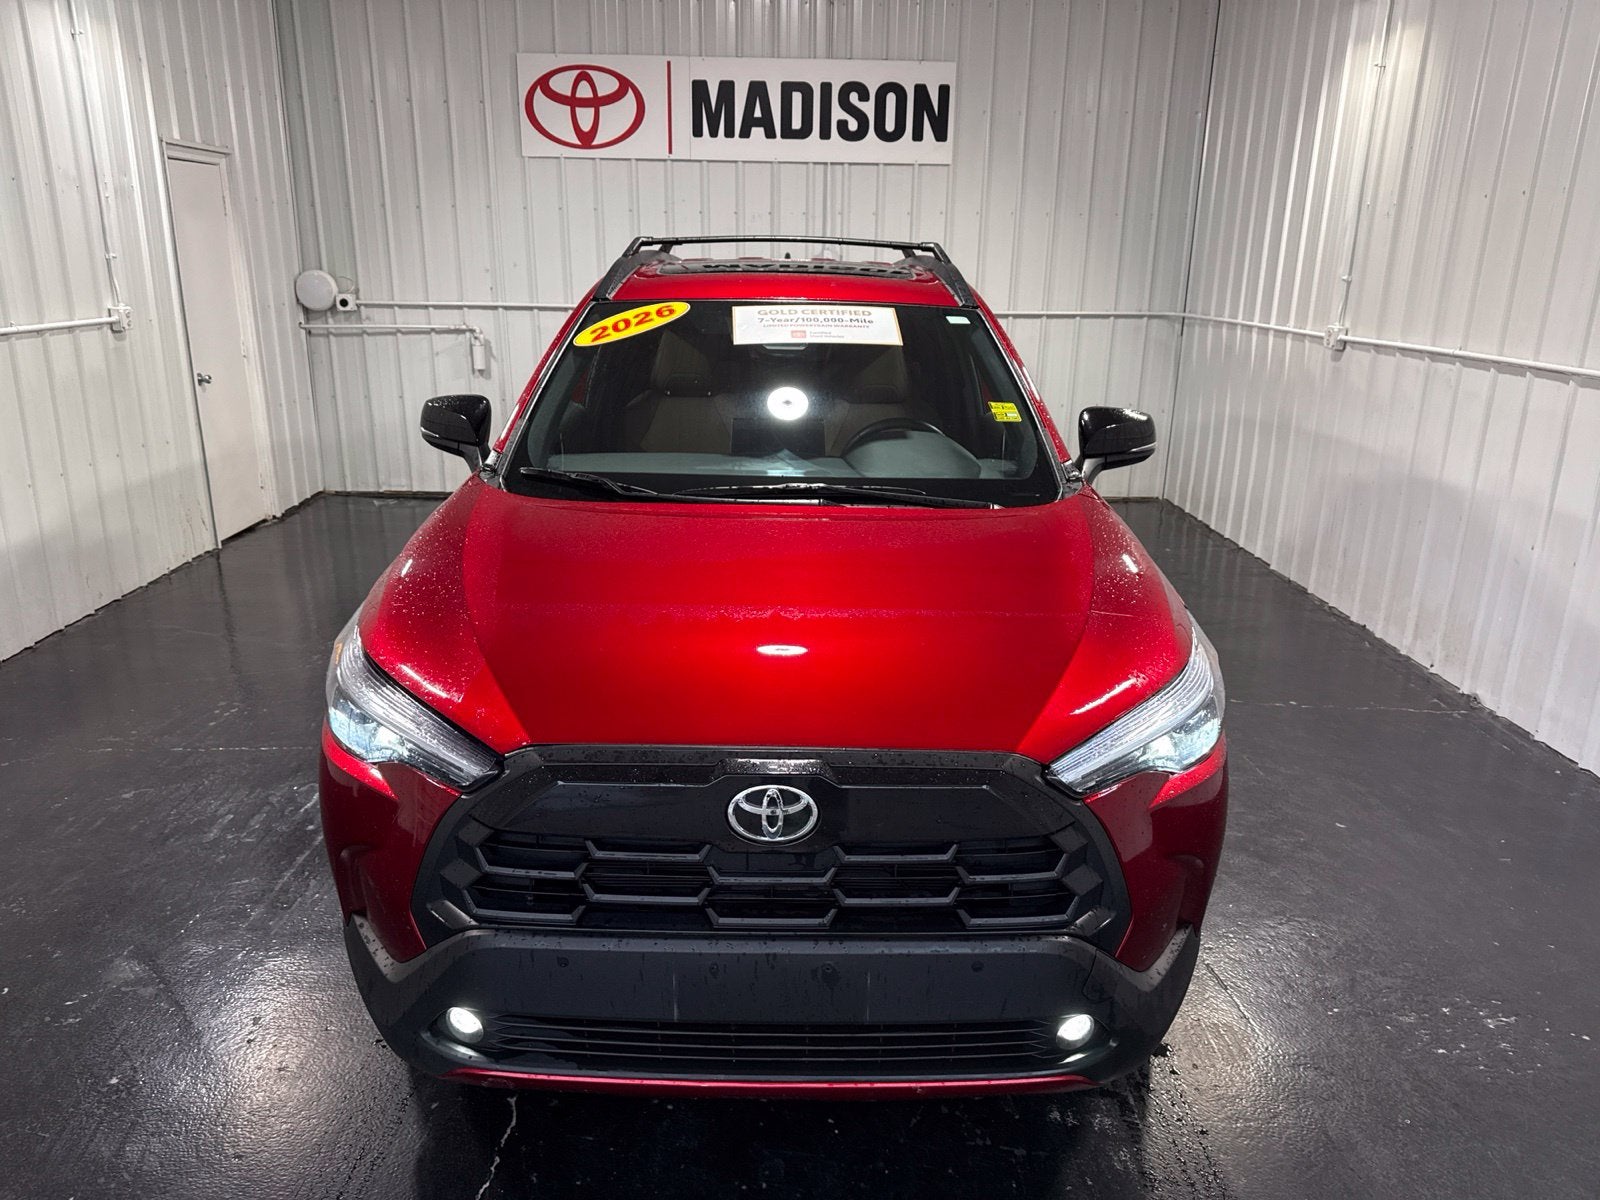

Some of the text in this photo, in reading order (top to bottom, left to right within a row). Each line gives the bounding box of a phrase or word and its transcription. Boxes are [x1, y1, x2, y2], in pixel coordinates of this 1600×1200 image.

[691, 79, 951, 143] MADISON
[590, 304, 676, 343] 2026
[801, 309, 872, 317] CERTIFIED
